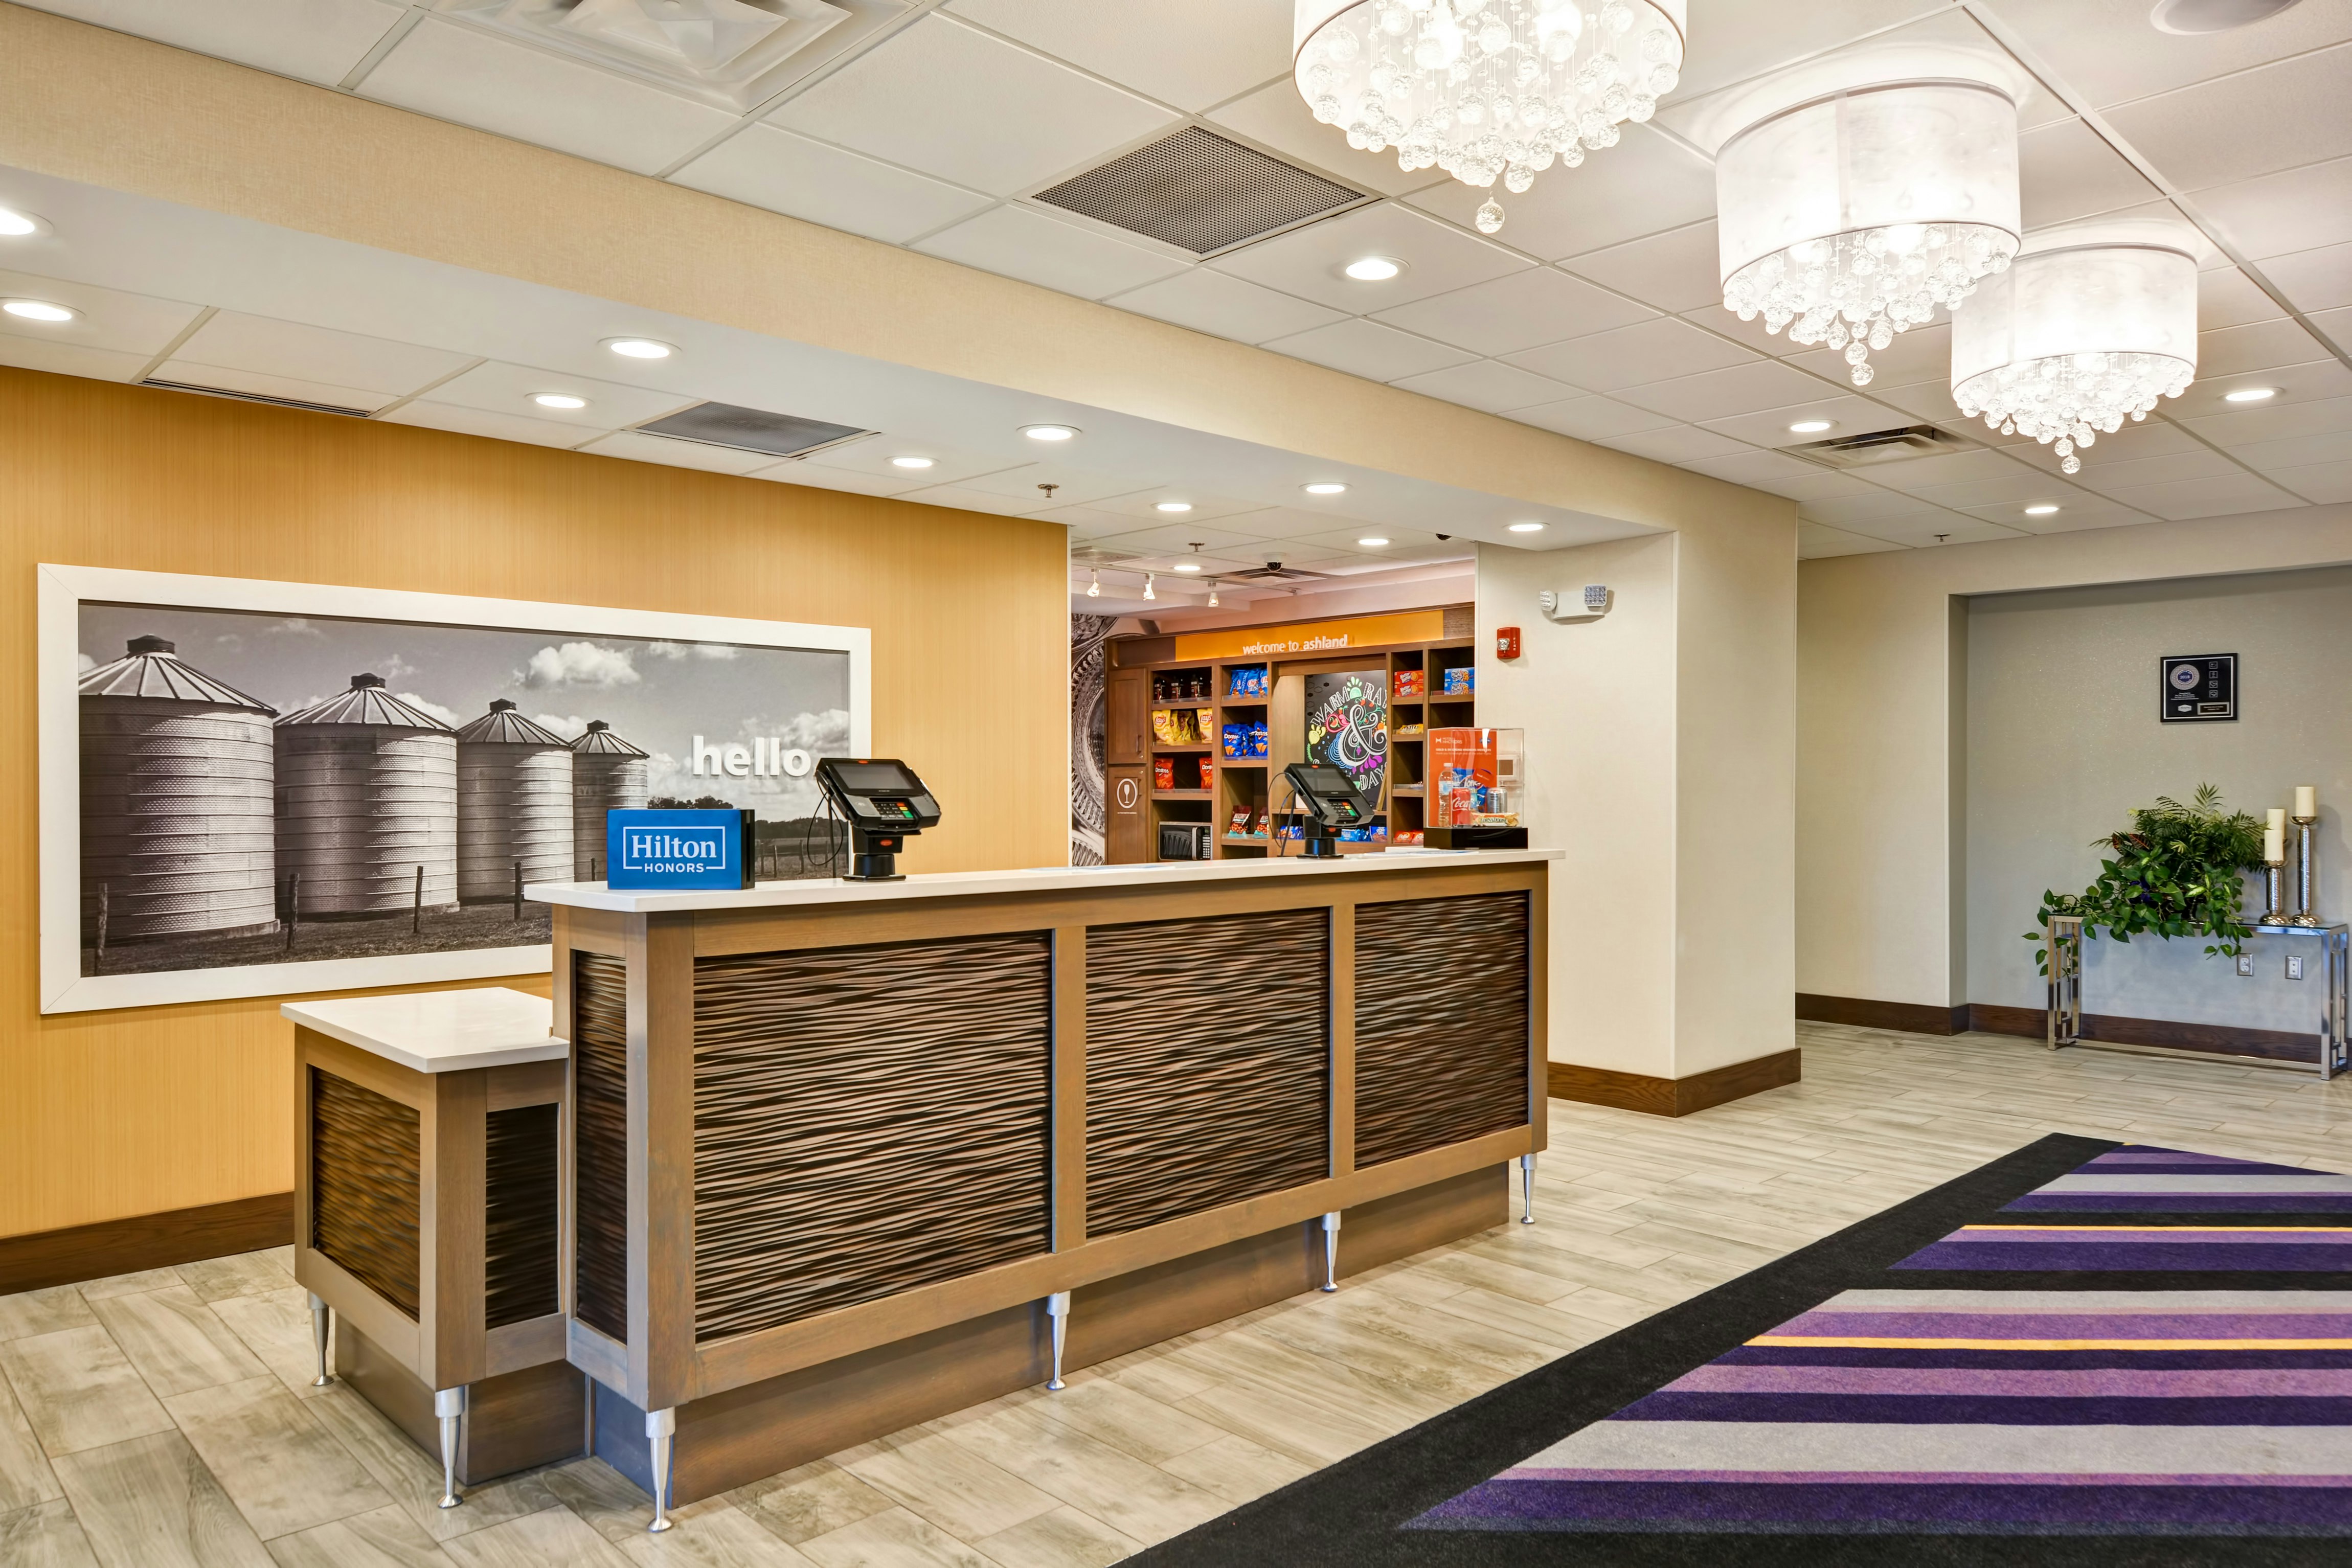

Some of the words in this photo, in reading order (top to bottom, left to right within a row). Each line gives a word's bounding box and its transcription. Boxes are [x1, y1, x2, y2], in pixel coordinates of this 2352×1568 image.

[1243, 642, 1285, 655] welcome
[1288, 640, 1299, 651] to
[1303, 634, 1348, 650] ashland
[1201, 714, 1212, 722] Lay's
[1310, 686, 1351, 727] WARM
[1338, 704, 1388, 767] &
[692, 735, 811, 777] hello
[631, 835, 717, 858] Hilton
[644, 862, 704, 873] HONORS
